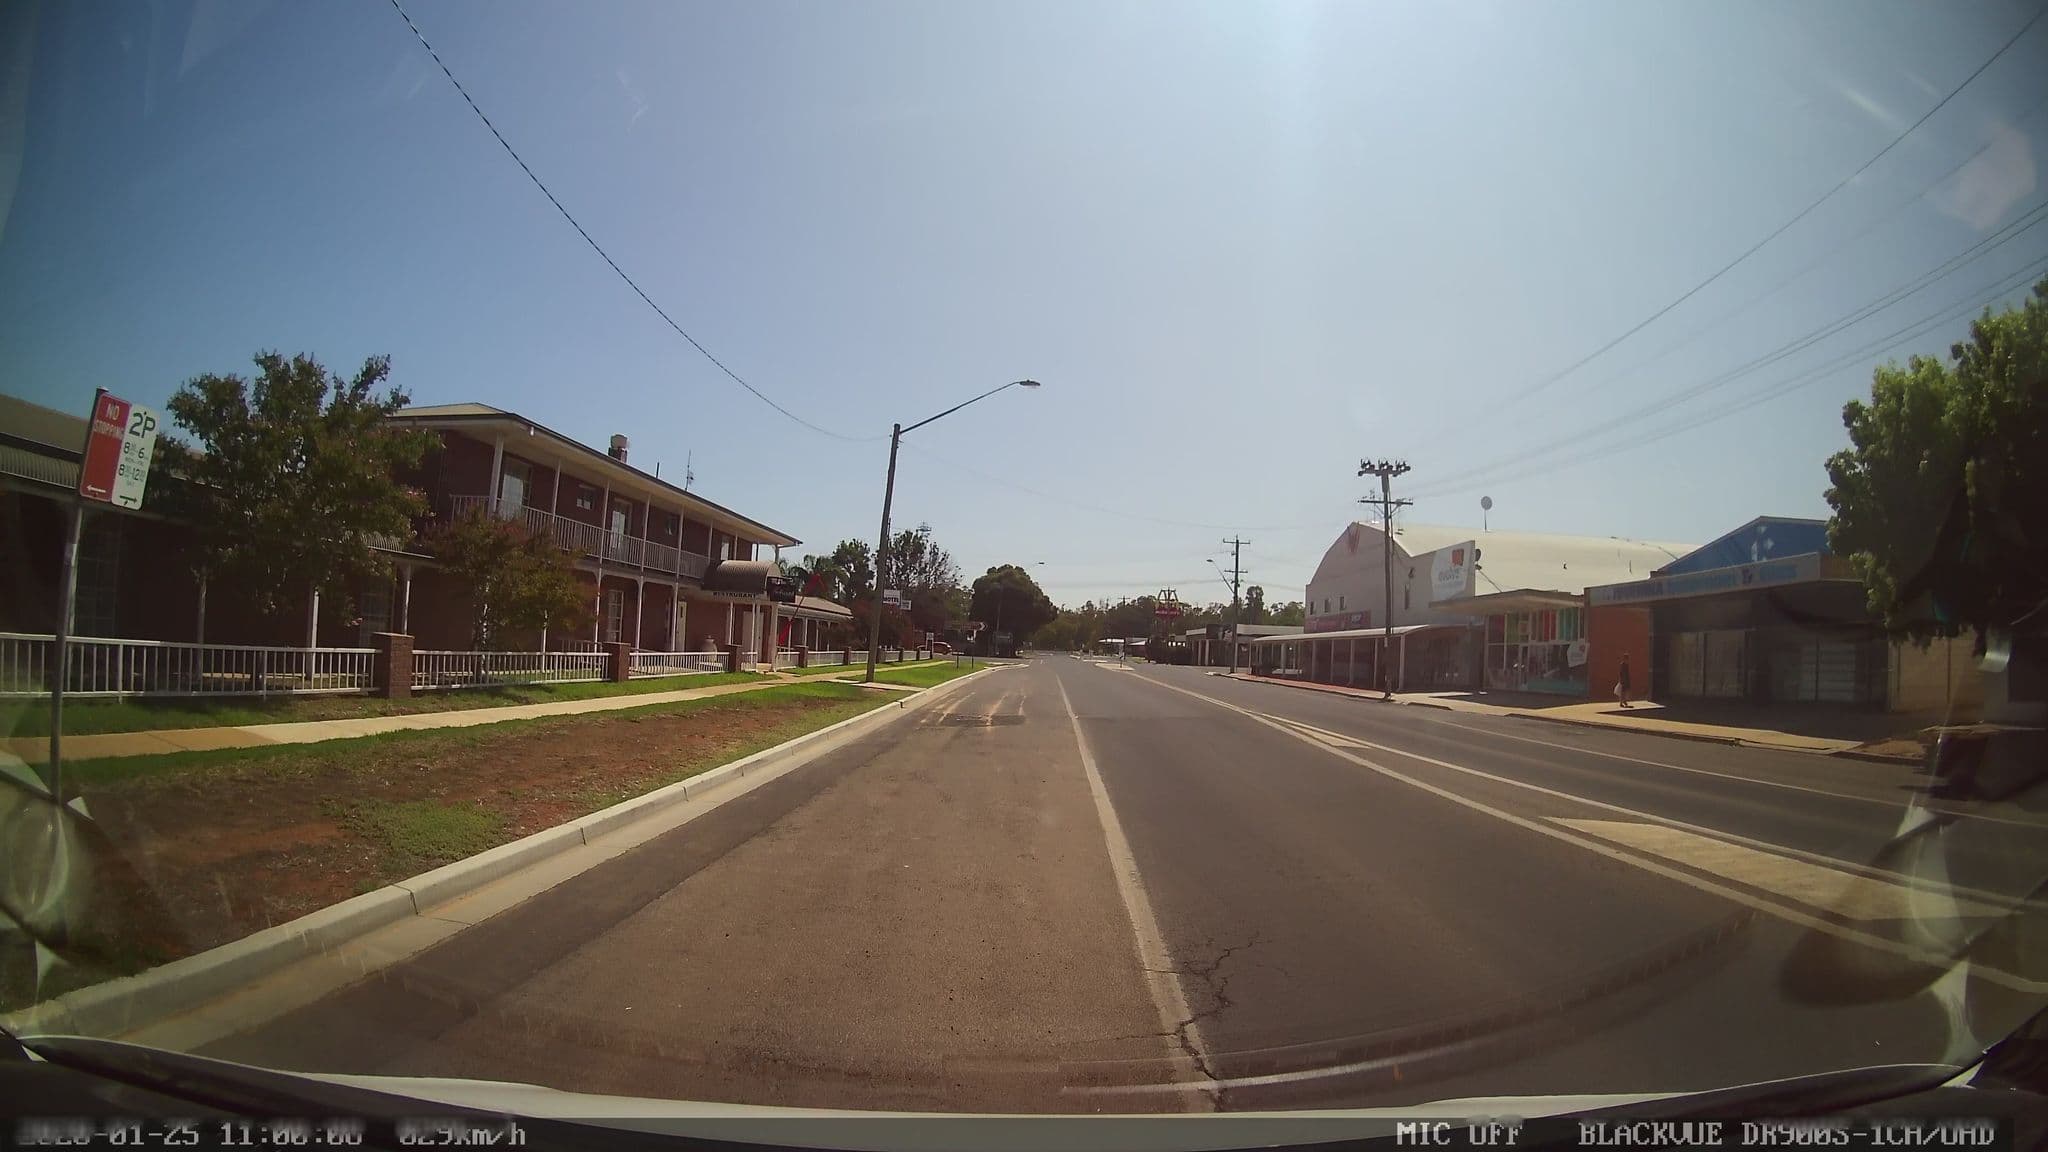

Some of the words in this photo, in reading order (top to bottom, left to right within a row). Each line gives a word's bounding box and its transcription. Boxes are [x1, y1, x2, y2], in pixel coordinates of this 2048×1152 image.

[106, 403, 120, 420] NO
[94, 419, 123, 439] STOPPING
[129, 411, 156, 438] 2P
[712, 591, 756, 599] RESTAURANT
